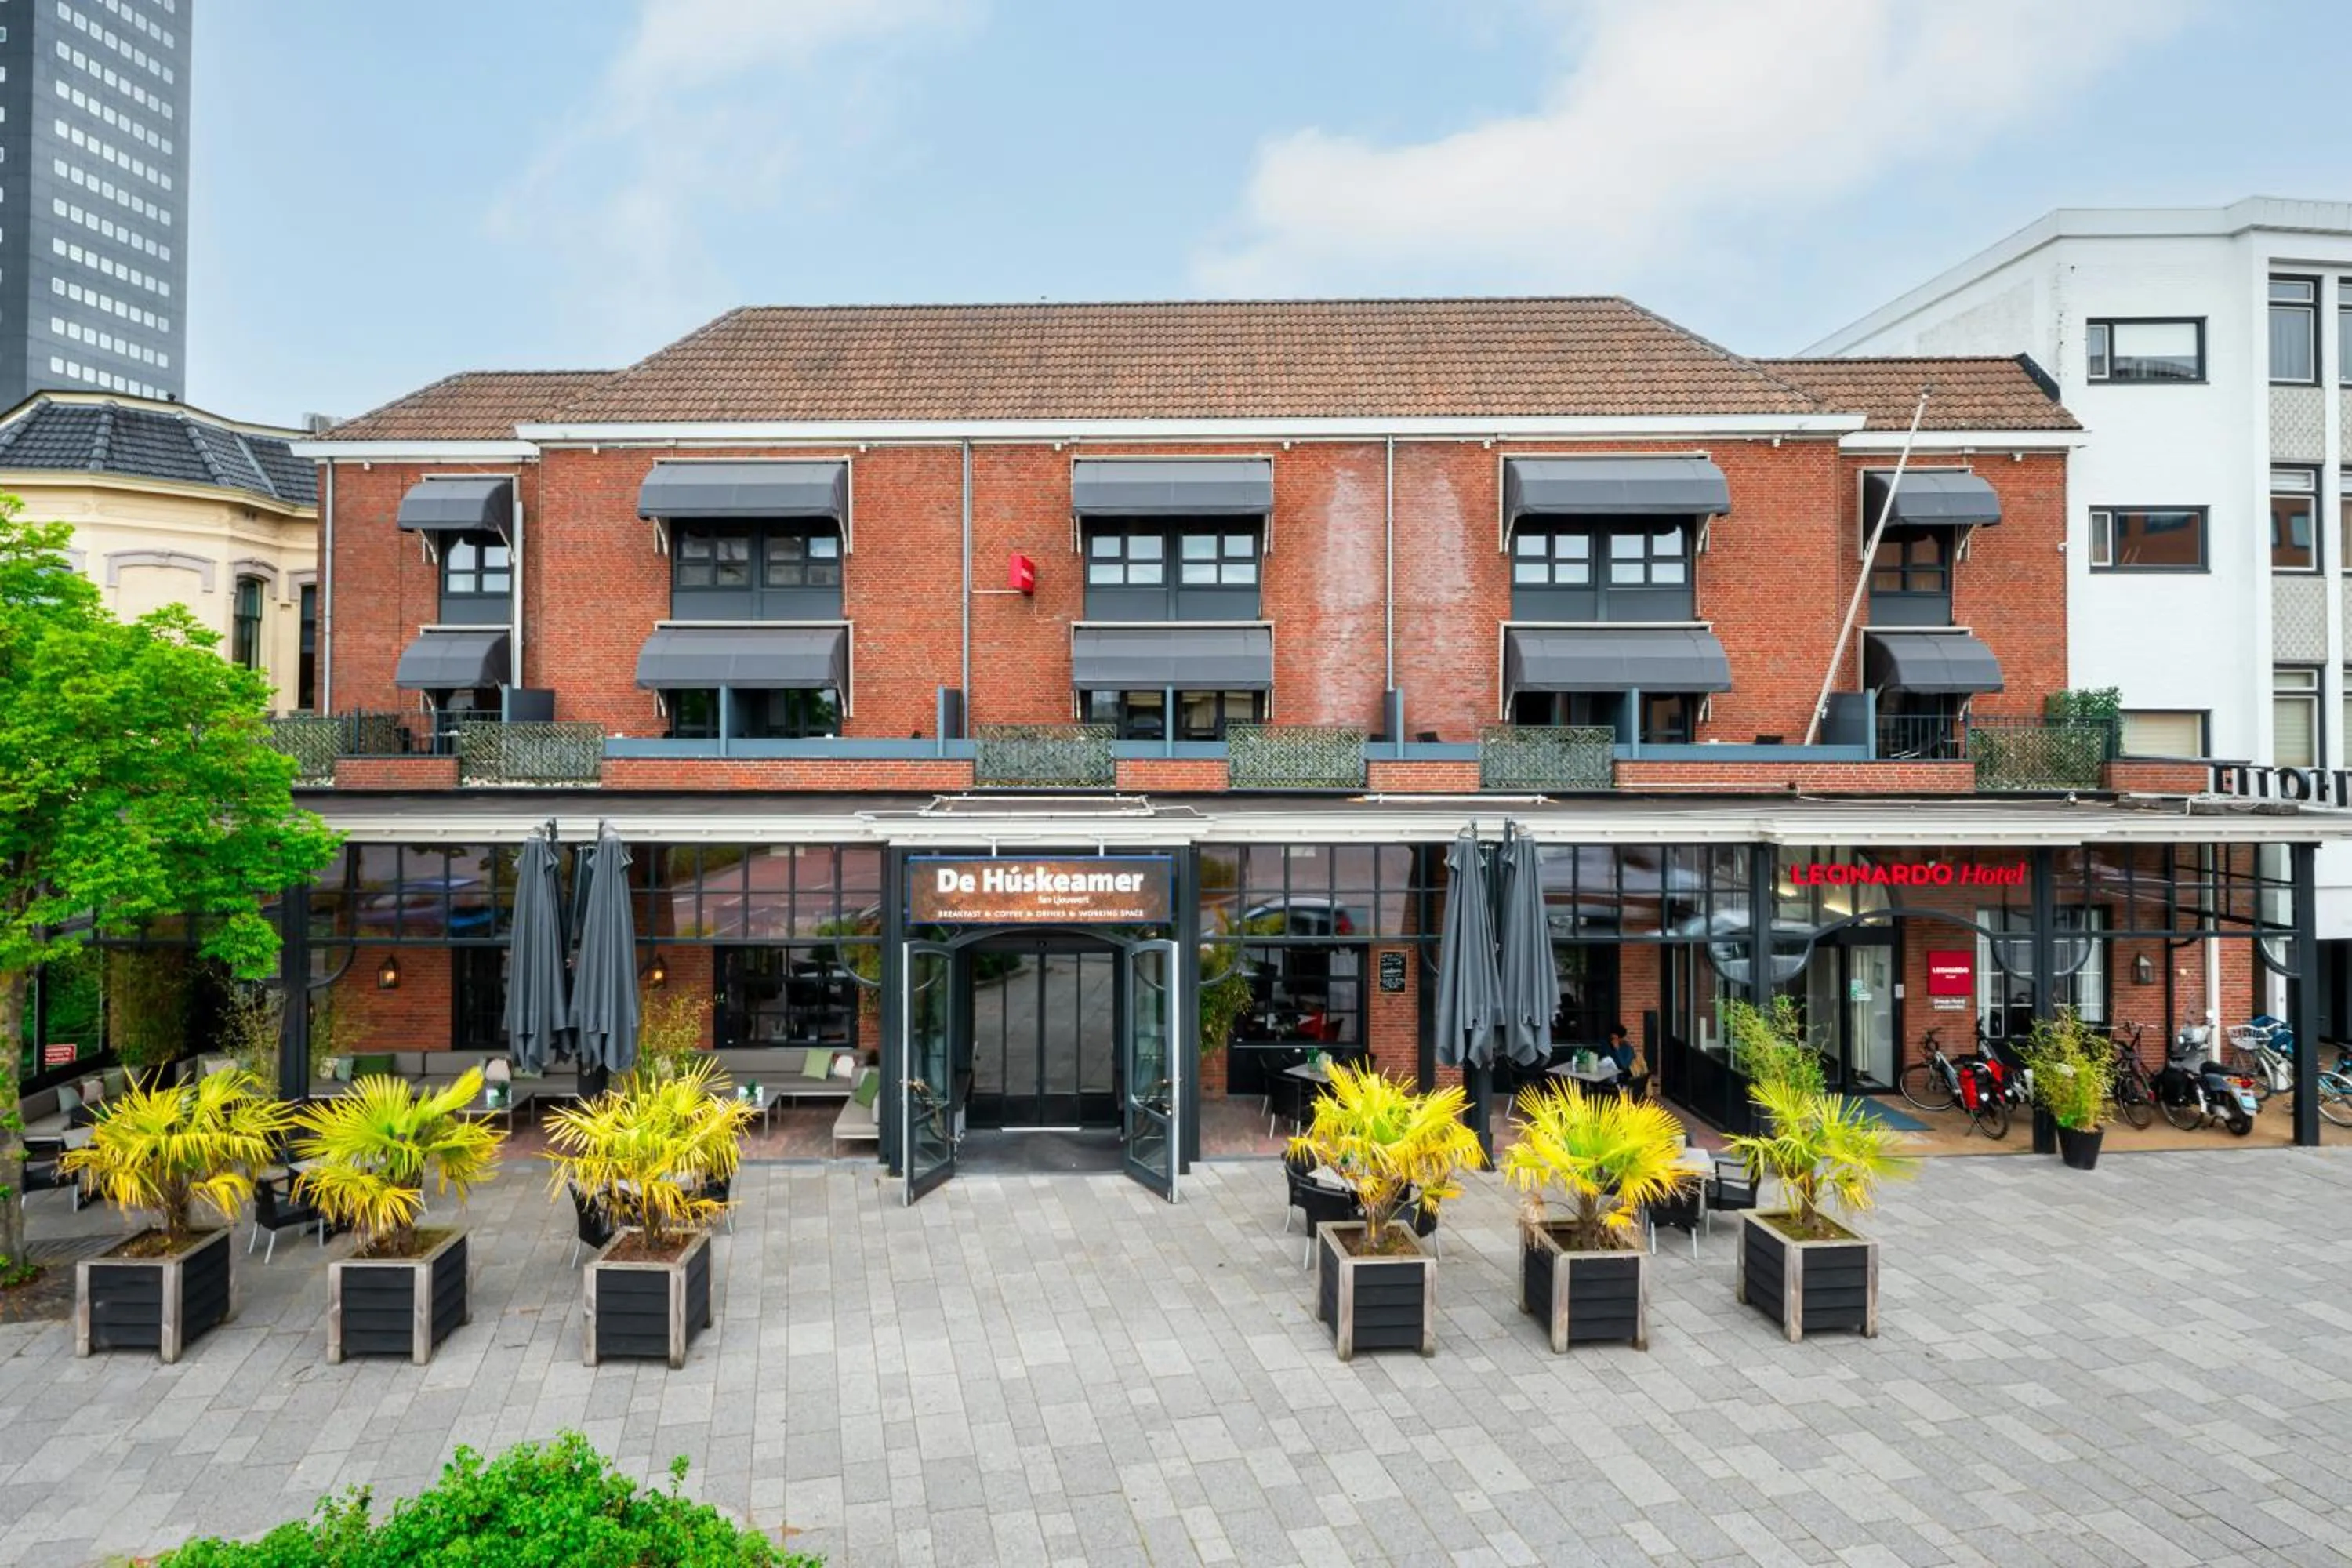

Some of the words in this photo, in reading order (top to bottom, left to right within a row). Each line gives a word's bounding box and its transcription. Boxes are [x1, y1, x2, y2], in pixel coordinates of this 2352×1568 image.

[937, 868, 976, 893] De
[982, 866, 1144, 893] Húskeamer
[1791, 863, 1953, 885] LEONARDO
[1959, 862, 2026, 885] Hotel
[937, 909, 982, 918] BREAKFAST
[993, 909, 1024, 918] COFFEE
[1035, 909, 1066, 918] DRINKS
[1078, 909, 1119, 918] WORKING
[1120, 909, 1144, 918] SPACE
